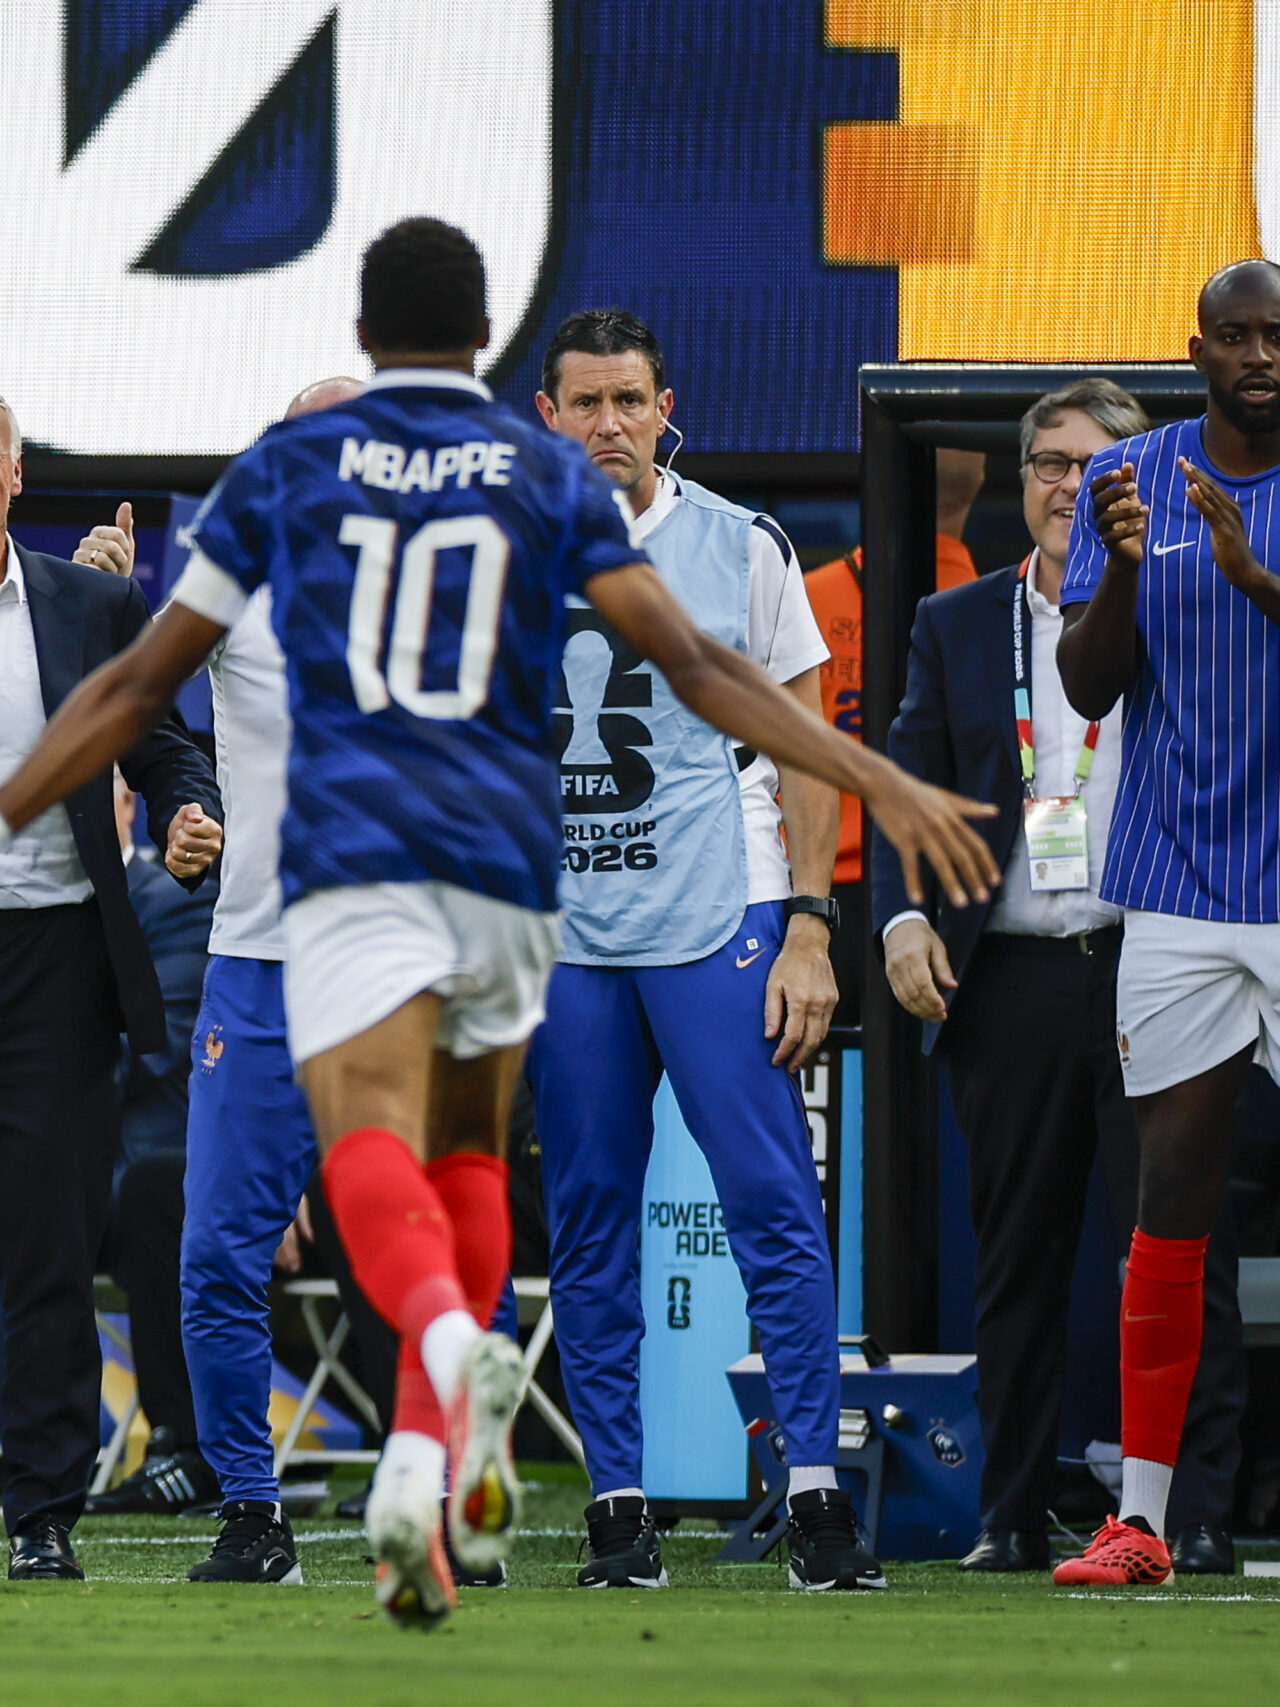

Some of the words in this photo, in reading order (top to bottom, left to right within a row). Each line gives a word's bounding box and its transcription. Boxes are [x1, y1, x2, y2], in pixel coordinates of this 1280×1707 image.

[338, 437, 517, 493] MBAPPE
[338, 513, 510, 722] 10
[560, 775, 619, 796] FIFA
[563, 823, 606, 841] RLD
[610, 821, 656, 838] CUP
[648, 1202, 725, 1228] POWER
[676, 1231, 728, 1256] ADE
